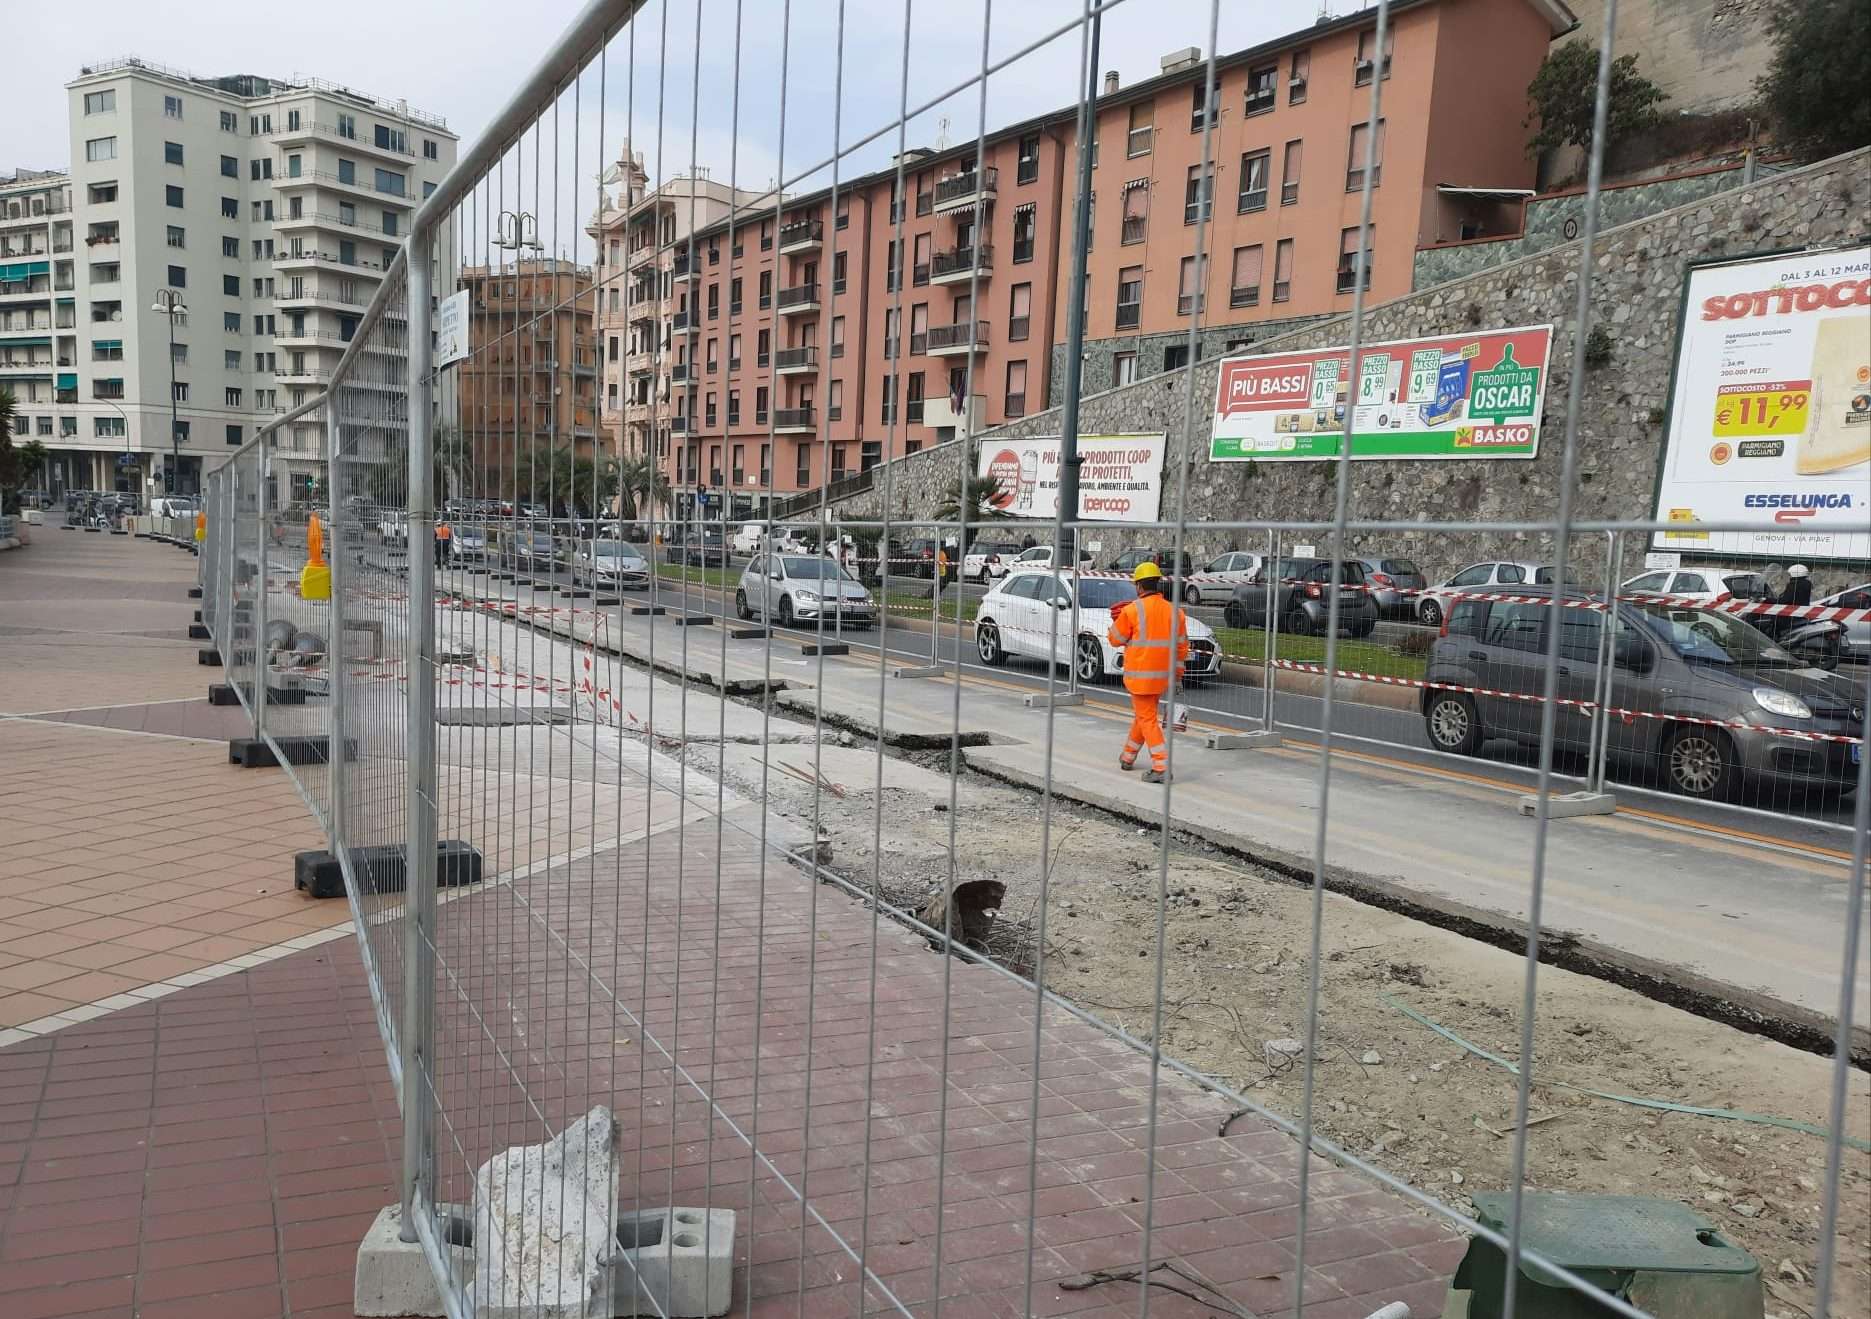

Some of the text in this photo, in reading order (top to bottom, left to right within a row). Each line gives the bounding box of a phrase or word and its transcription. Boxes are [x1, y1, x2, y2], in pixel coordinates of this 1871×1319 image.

[1781, 263, 1870, 281] DAL 3 AL 12 MAR
[1363, 355, 1388, 366] PREZZO
[1414, 350, 1440, 362] PREZZO
[1315, 360, 1339, 371] PREZZO
[1363, 364, 1387, 374] BASSO
[1413, 360, 1440, 371] BASSO
[1315, 369, 1338, 379] BASSO
[1479, 371, 1533, 386] PRODOTTI DA
[1233, 375, 1306, 397] PIÙ BASSI
[1720, 384, 1766, 393] SOTTOCOSTO
[1474, 385, 1533, 410] OSCAR
[1739, 393, 1808, 429] 11,99
[1474, 427, 1529, 443] BASKO
[1741, 441, 1782, 449] PARMIGIANO
[1042, 449, 1056, 464] PIÙ
[1084, 450, 1126, 465] PRODOTTI
[1128, 449, 1151, 464] COOP
[1744, 448, 1777, 456] REGGIANO
[1097, 482, 1122, 491] AMBIENTE
[1083, 493, 1130, 515] ipercoop
[1744, 494, 1852, 508] ESSELUNGA
